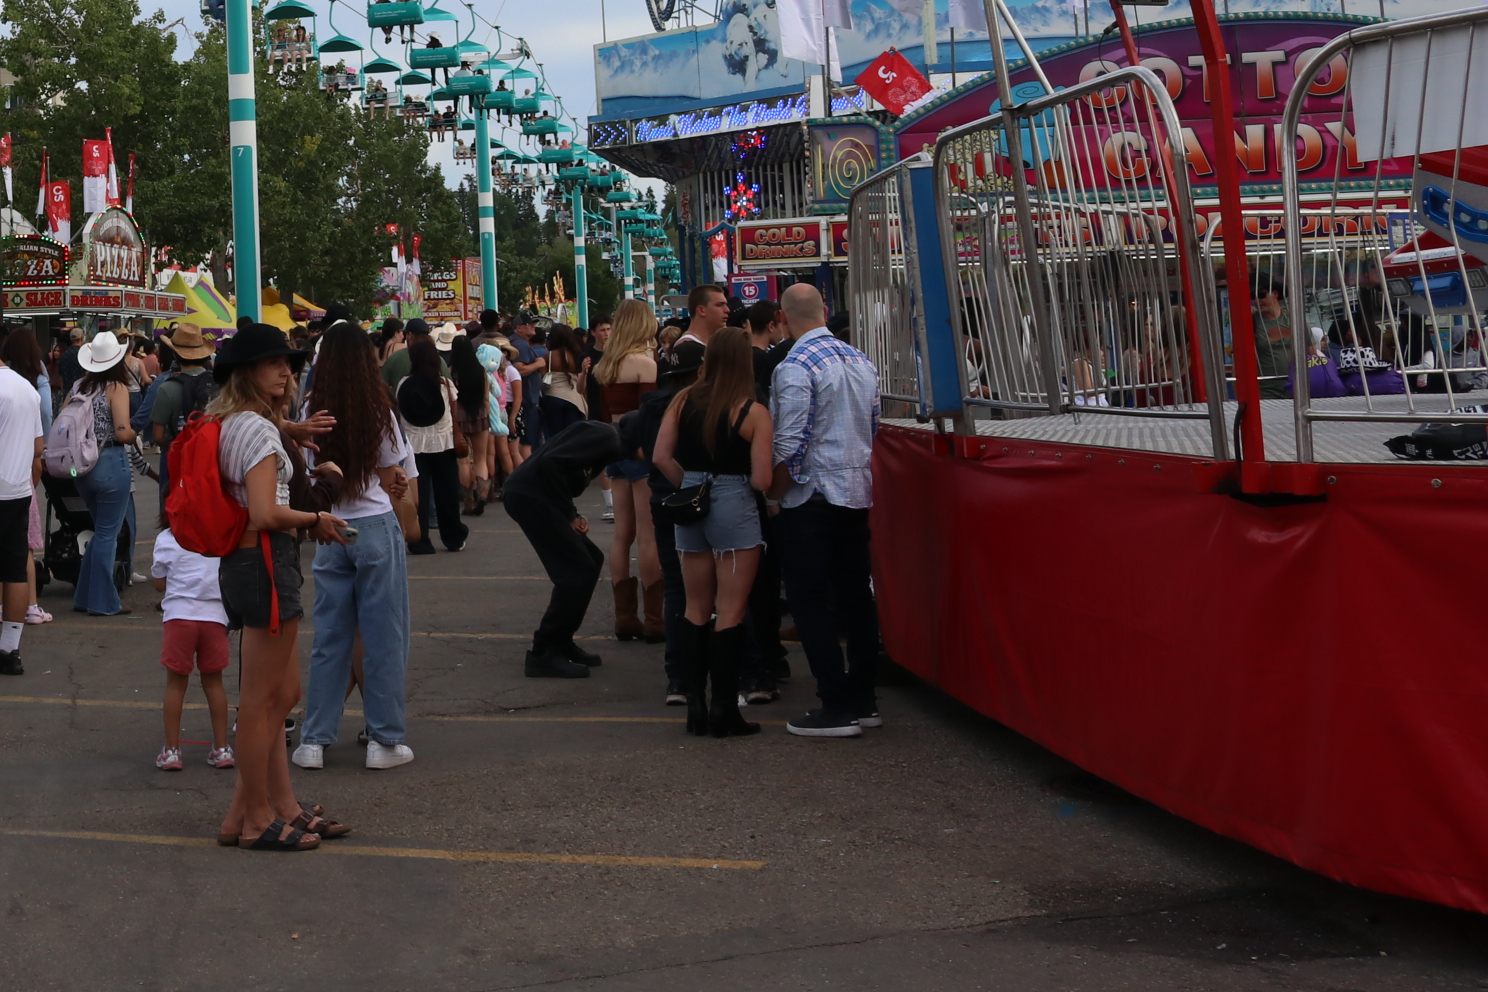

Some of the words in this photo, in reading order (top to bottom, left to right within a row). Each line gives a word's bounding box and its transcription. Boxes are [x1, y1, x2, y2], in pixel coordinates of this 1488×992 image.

[237, 148, 244, 157] 7
[52, 185, 64, 202] CS
[754, 226, 806, 244] COLD
[40, 246, 59, 256] STYLE
[745, 240, 816, 258] DRINKS
[95, 240, 140, 282] PIZZA
[424, 290, 455, 299] FRIES
[744, 286, 756, 296] 15
[25, 292, 62, 307] SLICE
[70, 294, 120, 307] DRINKS
